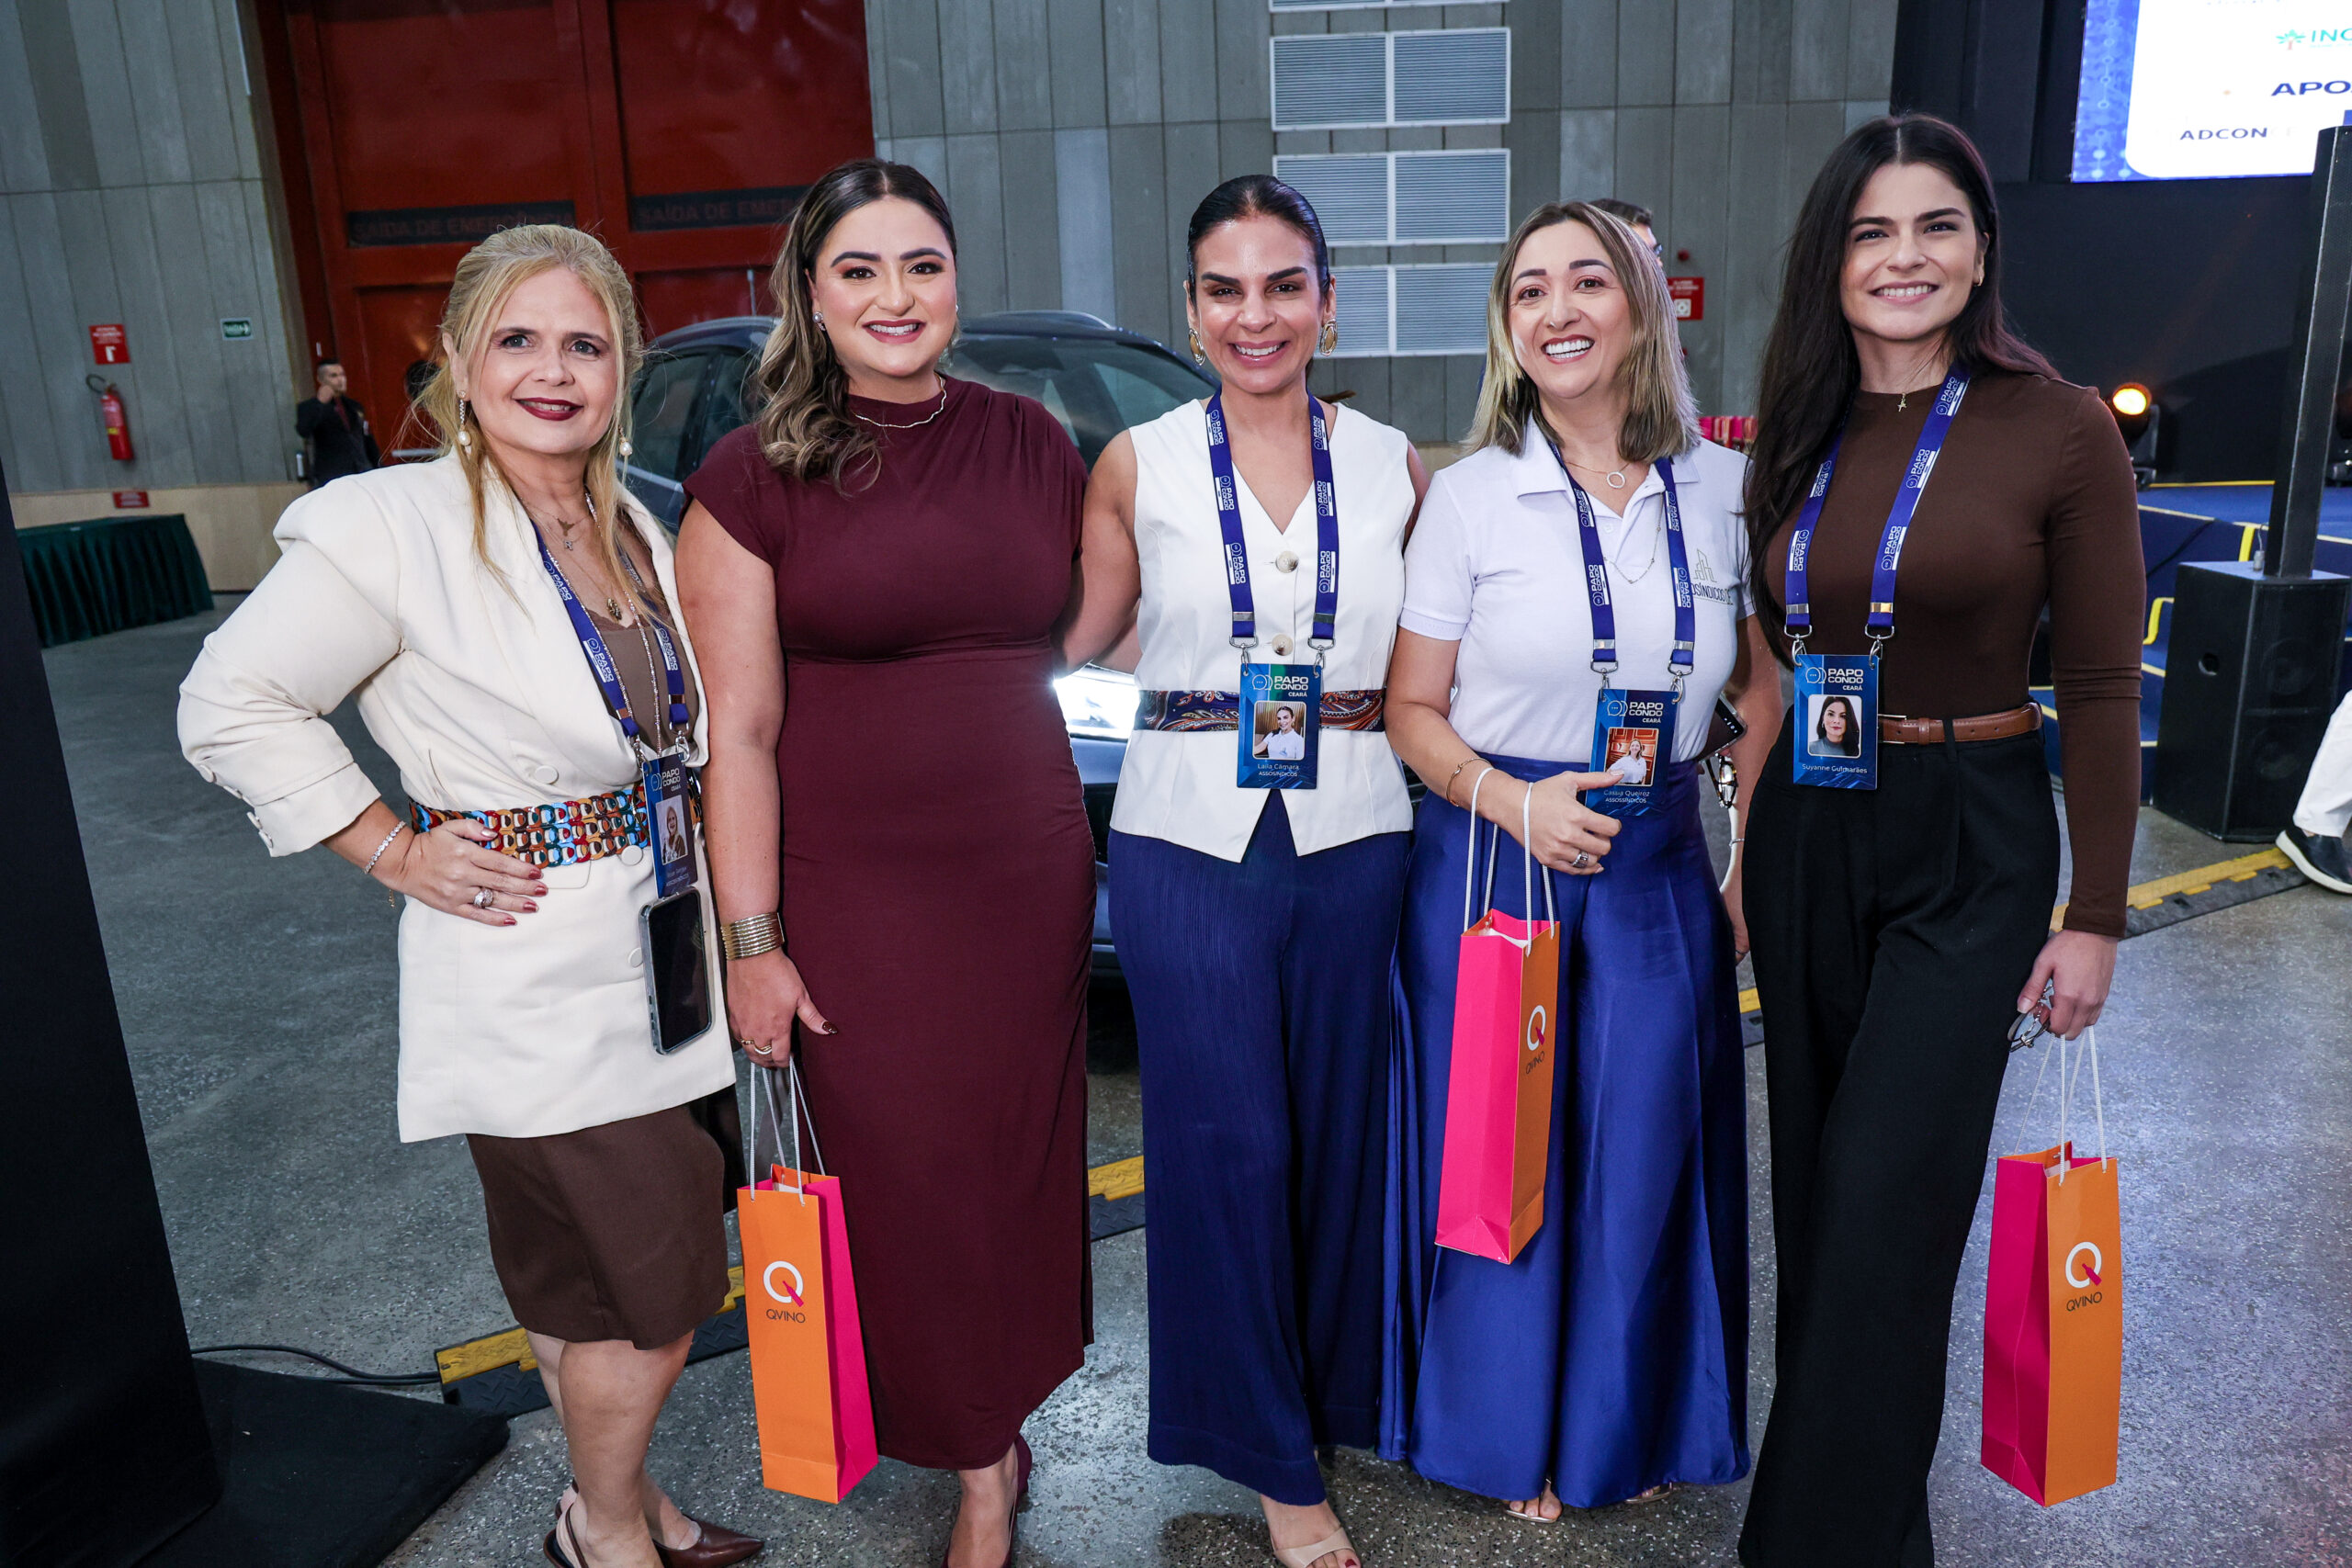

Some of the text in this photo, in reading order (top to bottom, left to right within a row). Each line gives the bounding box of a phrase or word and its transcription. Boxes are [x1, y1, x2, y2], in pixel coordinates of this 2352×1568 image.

[2271, 80, 2352, 96] APO
[2179, 127, 2268, 141] ADCON
[1940, 377, 1955, 401] PAPO
[1216, 421, 1224, 444] PAPO
[1910, 449, 1926, 474] PAPO
[1817, 473, 1828, 497] PAPO
[1226, 488, 1234, 510] PAPO
[1884, 525, 1897, 554] PAPO
[1797, 543, 1806, 571] PAPO
[1237, 556, 1246, 583] PAPO
[1589, 564, 1597, 592] PAPO
[553, 574, 572, 600] PAPO
[598, 653, 615, 682] PAPO
[665, 642, 678, 671] PAPO
[1274, 675, 1308, 684] PAPO
[1827, 669, 1864, 677] PAPO
[1827, 676, 1864, 684] CONDO
[1629, 702, 1664, 710] PAPO
[662, 768, 680, 780] PAPO
[1802, 764, 1868, 773] Suyanne Guimarães
[663, 776, 681, 787] CONDO
[2066, 1292, 2103, 1312] QVINO
[766, 1309, 806, 1324] QVINO
